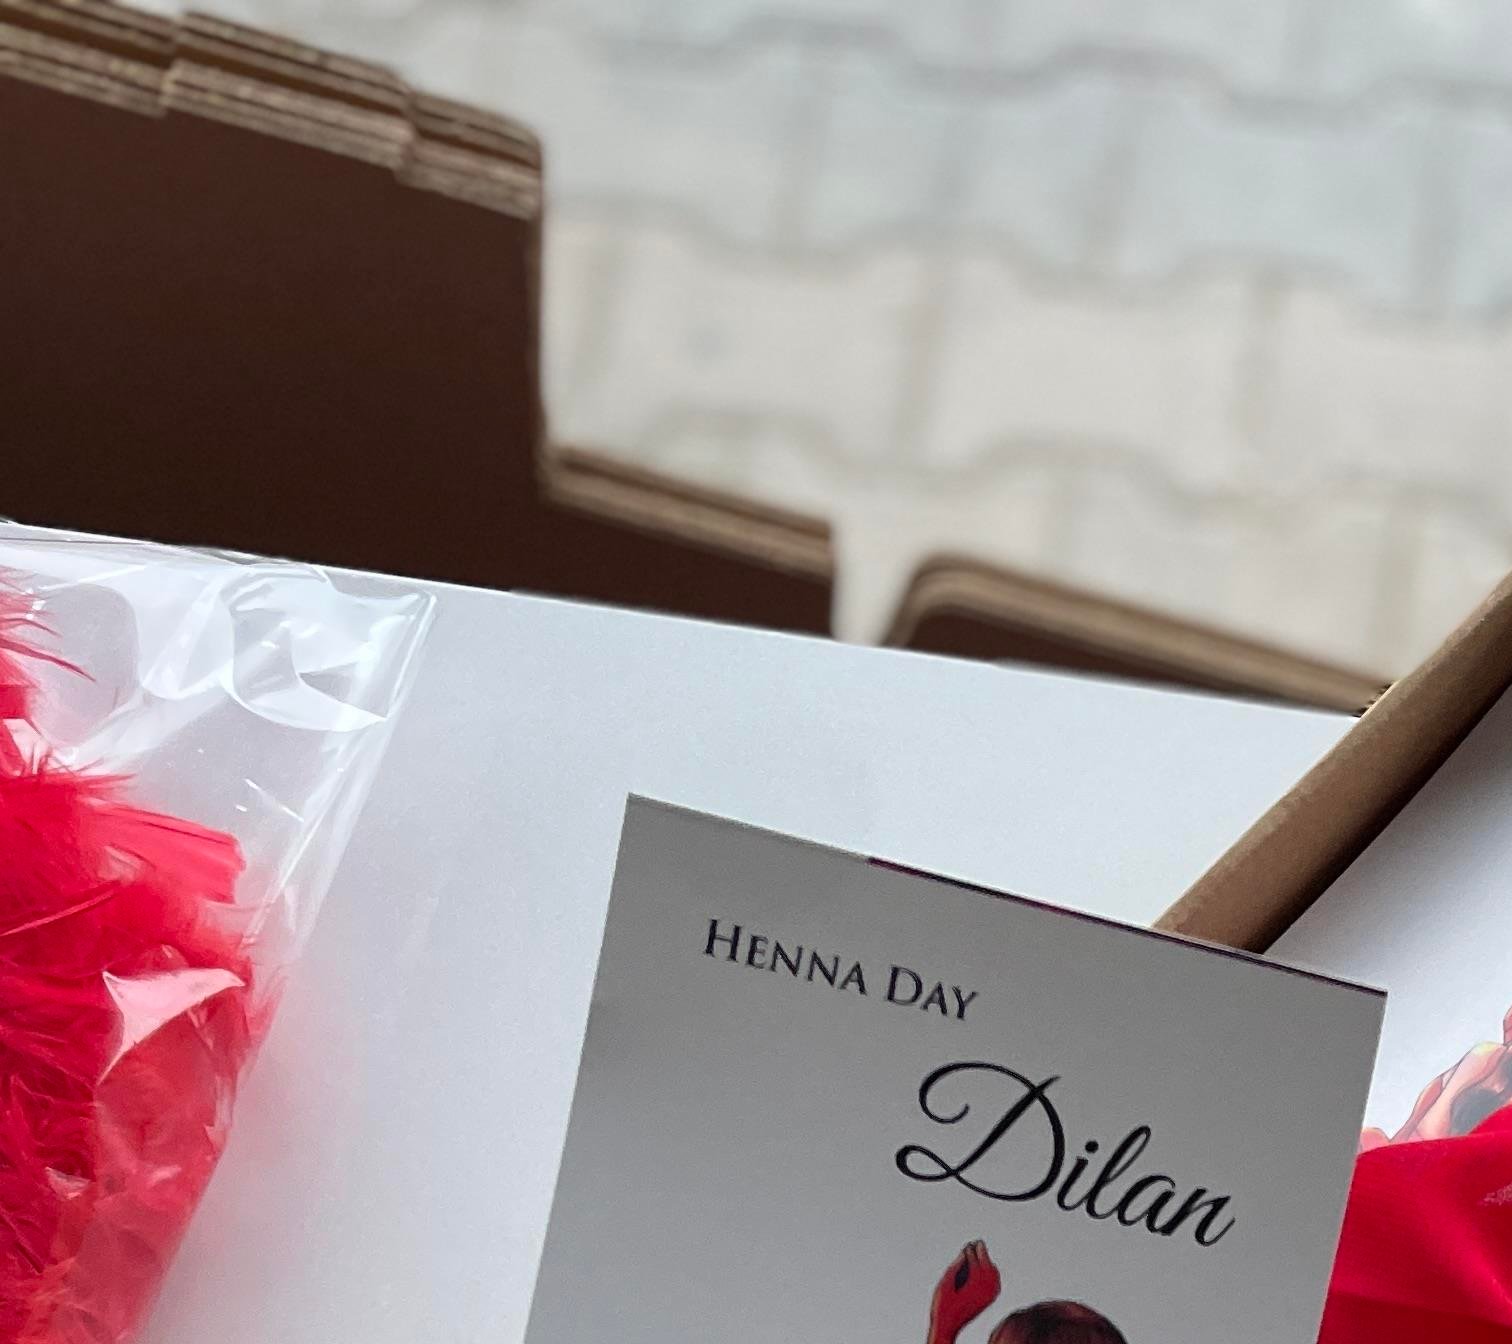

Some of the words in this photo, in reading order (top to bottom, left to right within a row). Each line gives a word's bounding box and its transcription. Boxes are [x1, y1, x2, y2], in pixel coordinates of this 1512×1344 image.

[703, 918, 867, 995] HENNA
[886, 965, 979, 1020] DAY
[896, 1061, 1235, 1245] Dilan
